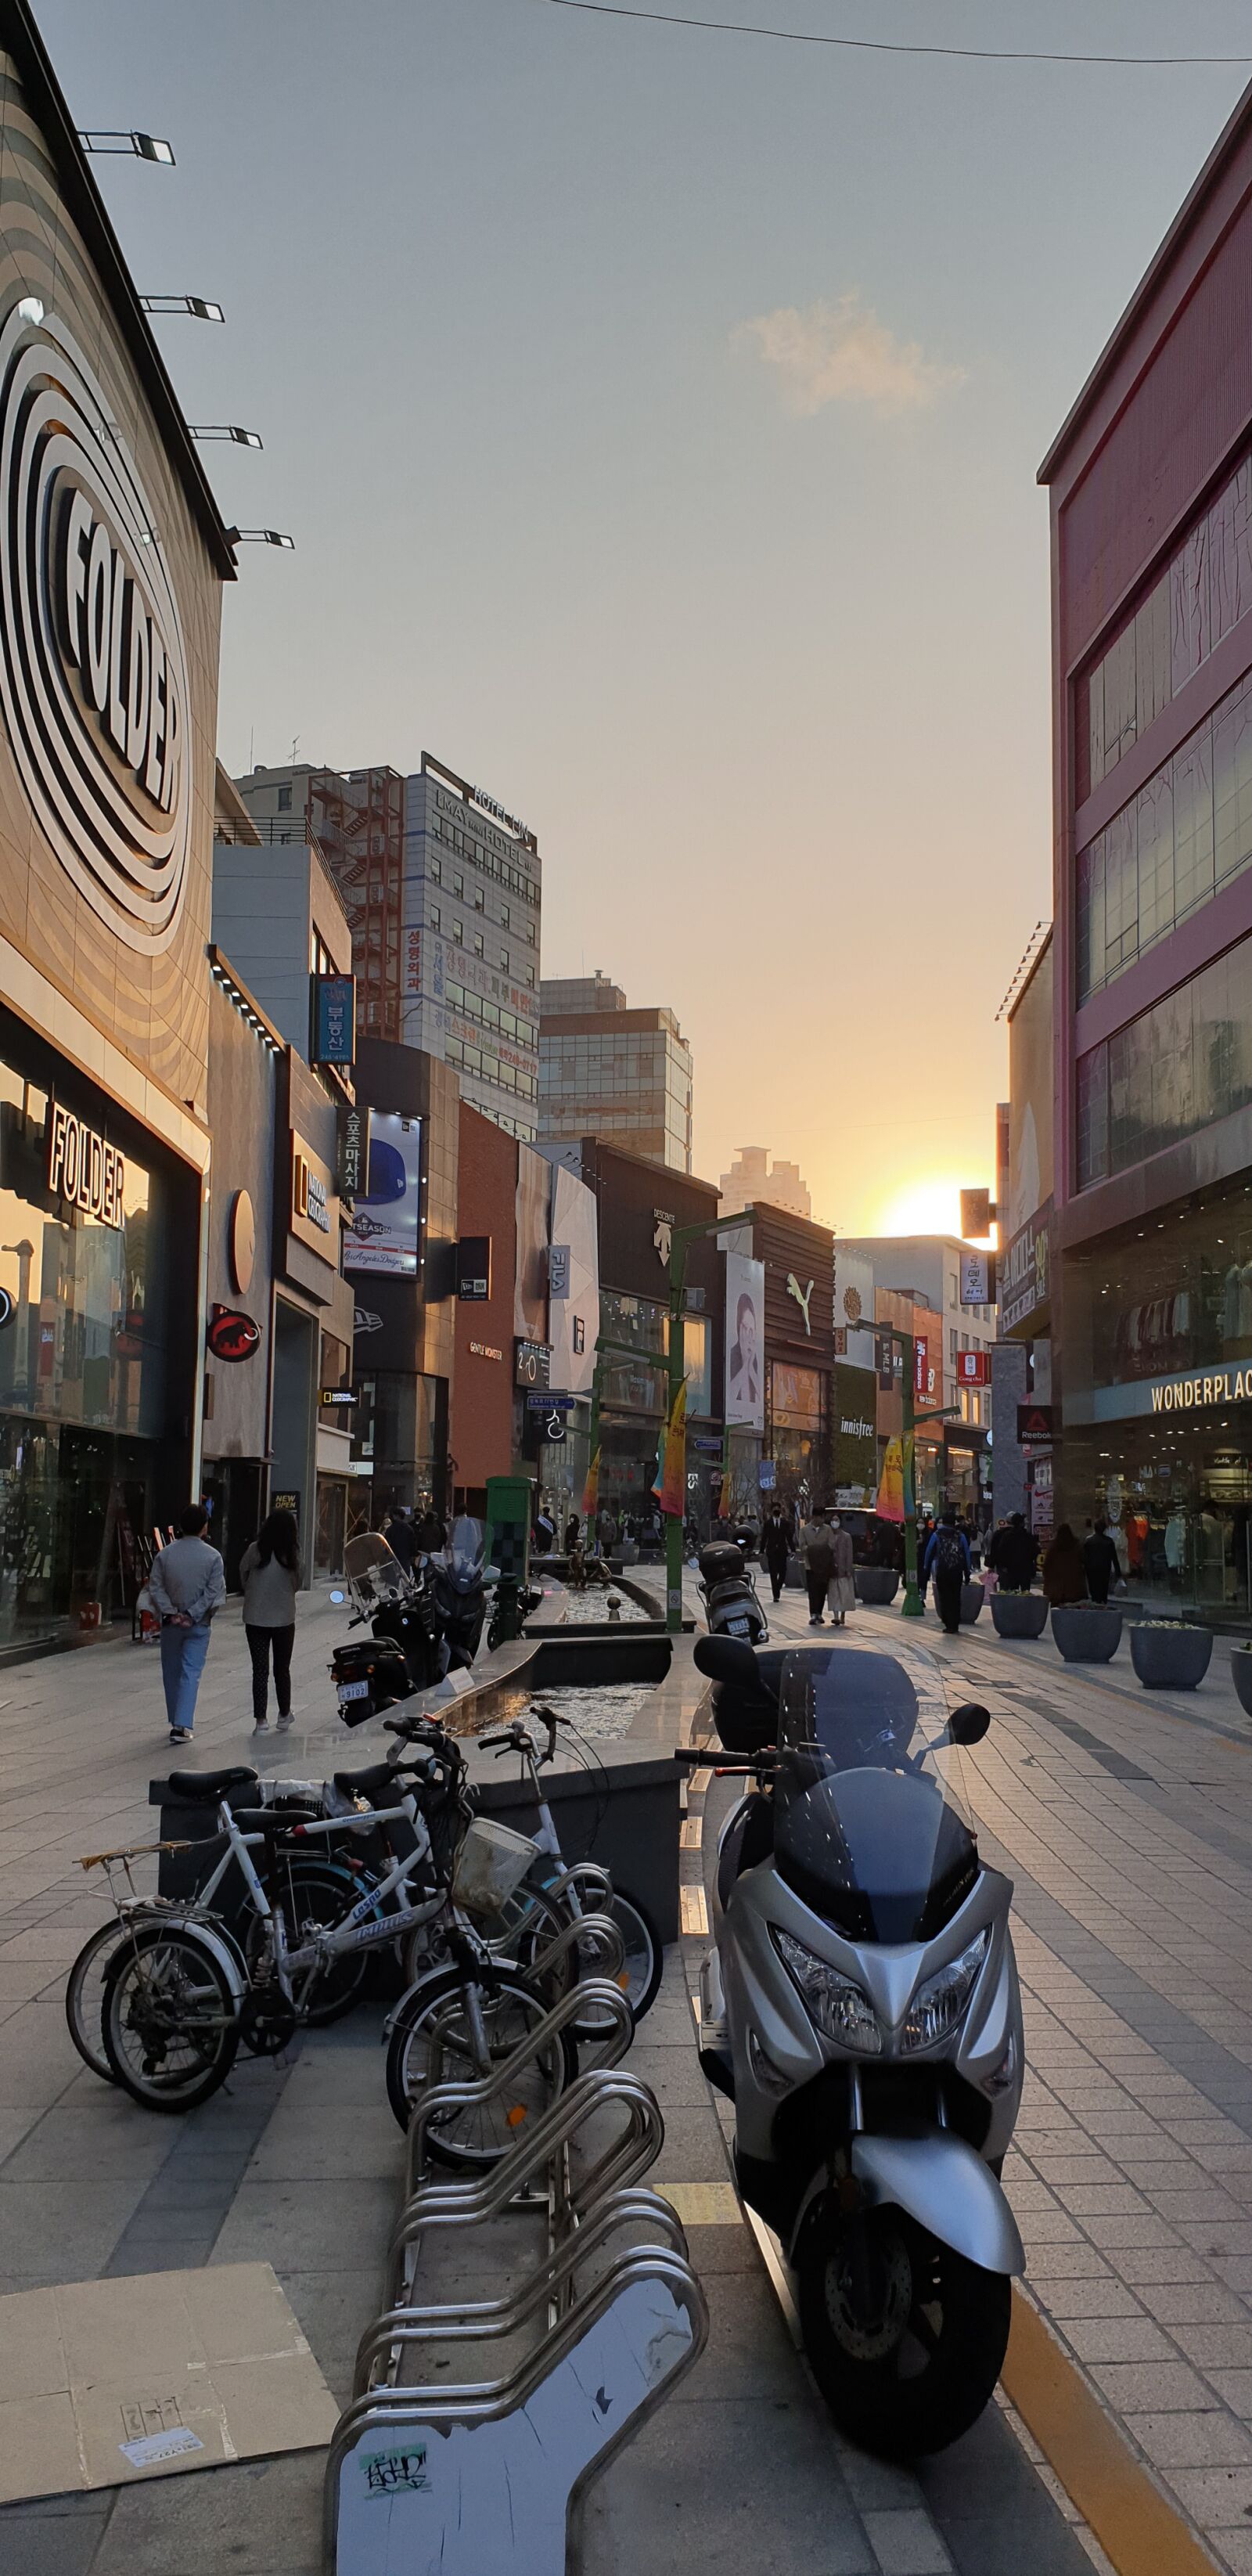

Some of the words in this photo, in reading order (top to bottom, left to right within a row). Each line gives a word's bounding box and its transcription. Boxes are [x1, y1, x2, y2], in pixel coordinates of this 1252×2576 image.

[66, 487, 182, 814] FOLDER
[327, 1006, 344, 1051] 부동산
[49, 1101, 126, 1228] FOLDER
[344, 1111, 361, 1191] 스포츠마사지
[352, 1222, 391, 1234] TSEASON
[653, 1208, 675, 1224] DESCENTE
[552, 1252, 566, 1291] FILA
[967, 1254, 982, 1287] 로데오
[470, 1342, 485, 1356] GENTLE
[484, 1346, 502, 1361] MONSTER
[1151, 1368, 1252, 1412] WONDERPLAC
[840, 1416, 874, 1439] innisfree
[275, 1494, 296, 1503] NEW
